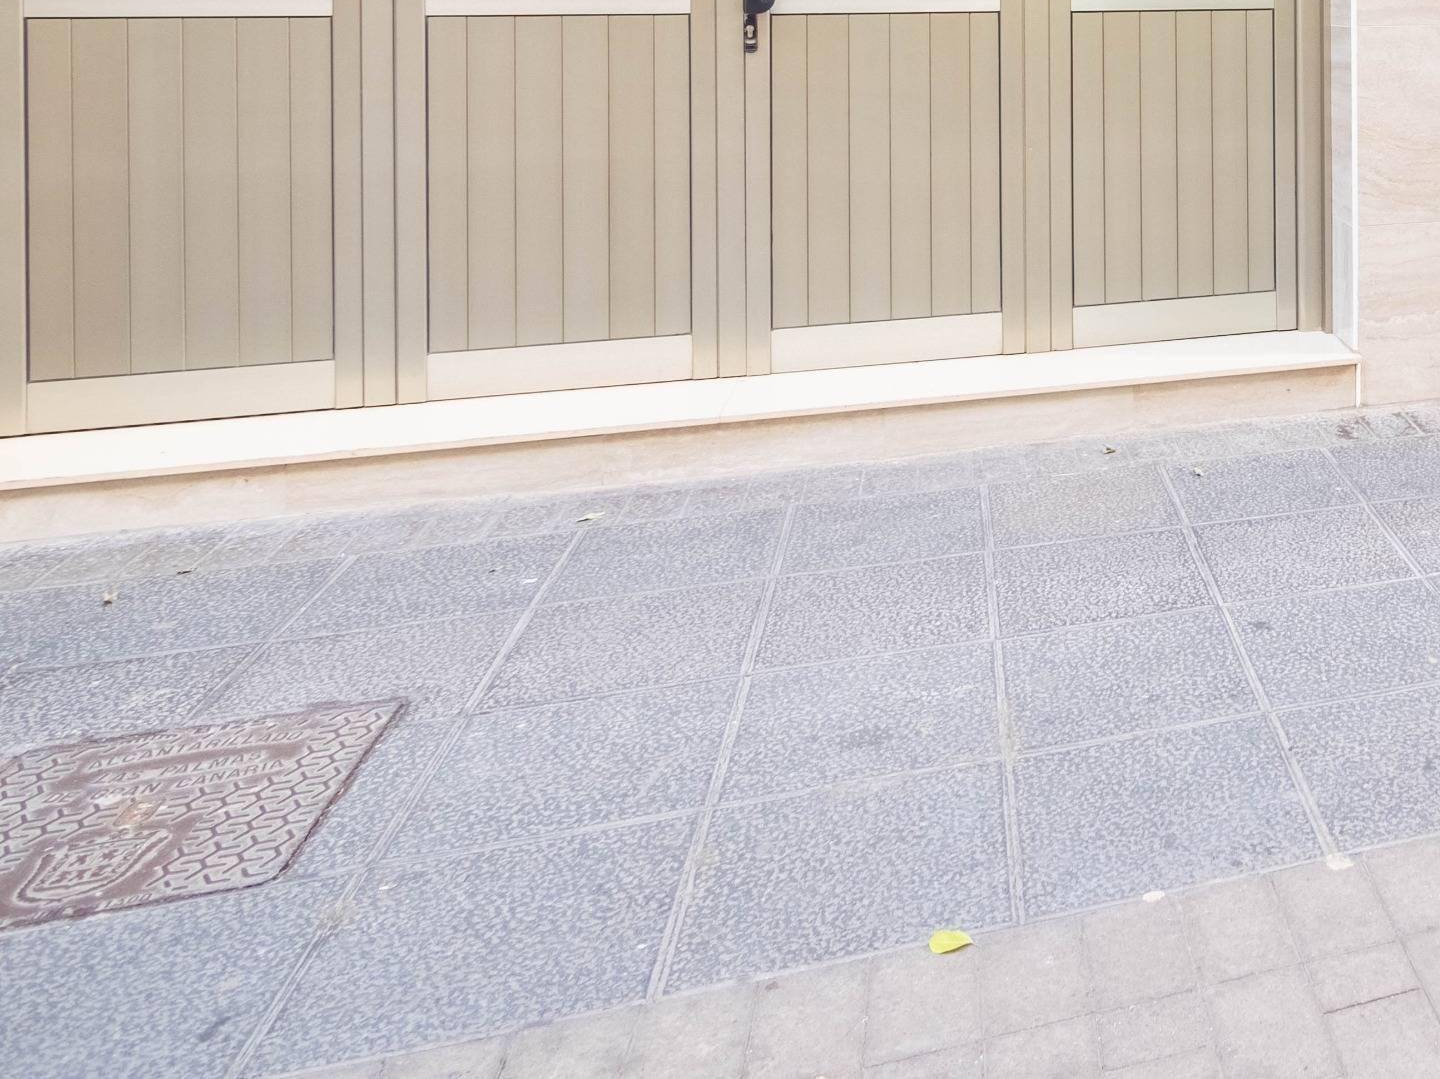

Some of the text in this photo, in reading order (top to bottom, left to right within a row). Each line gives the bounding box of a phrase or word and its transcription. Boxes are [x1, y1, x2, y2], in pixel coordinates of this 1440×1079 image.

[86, 730, 305, 770] ALCANTARILLADO
[94, 752, 264, 784] LAS PALMAS
[43, 791, 78, 804] DE
[174, 759, 285, 789] CANARIA
